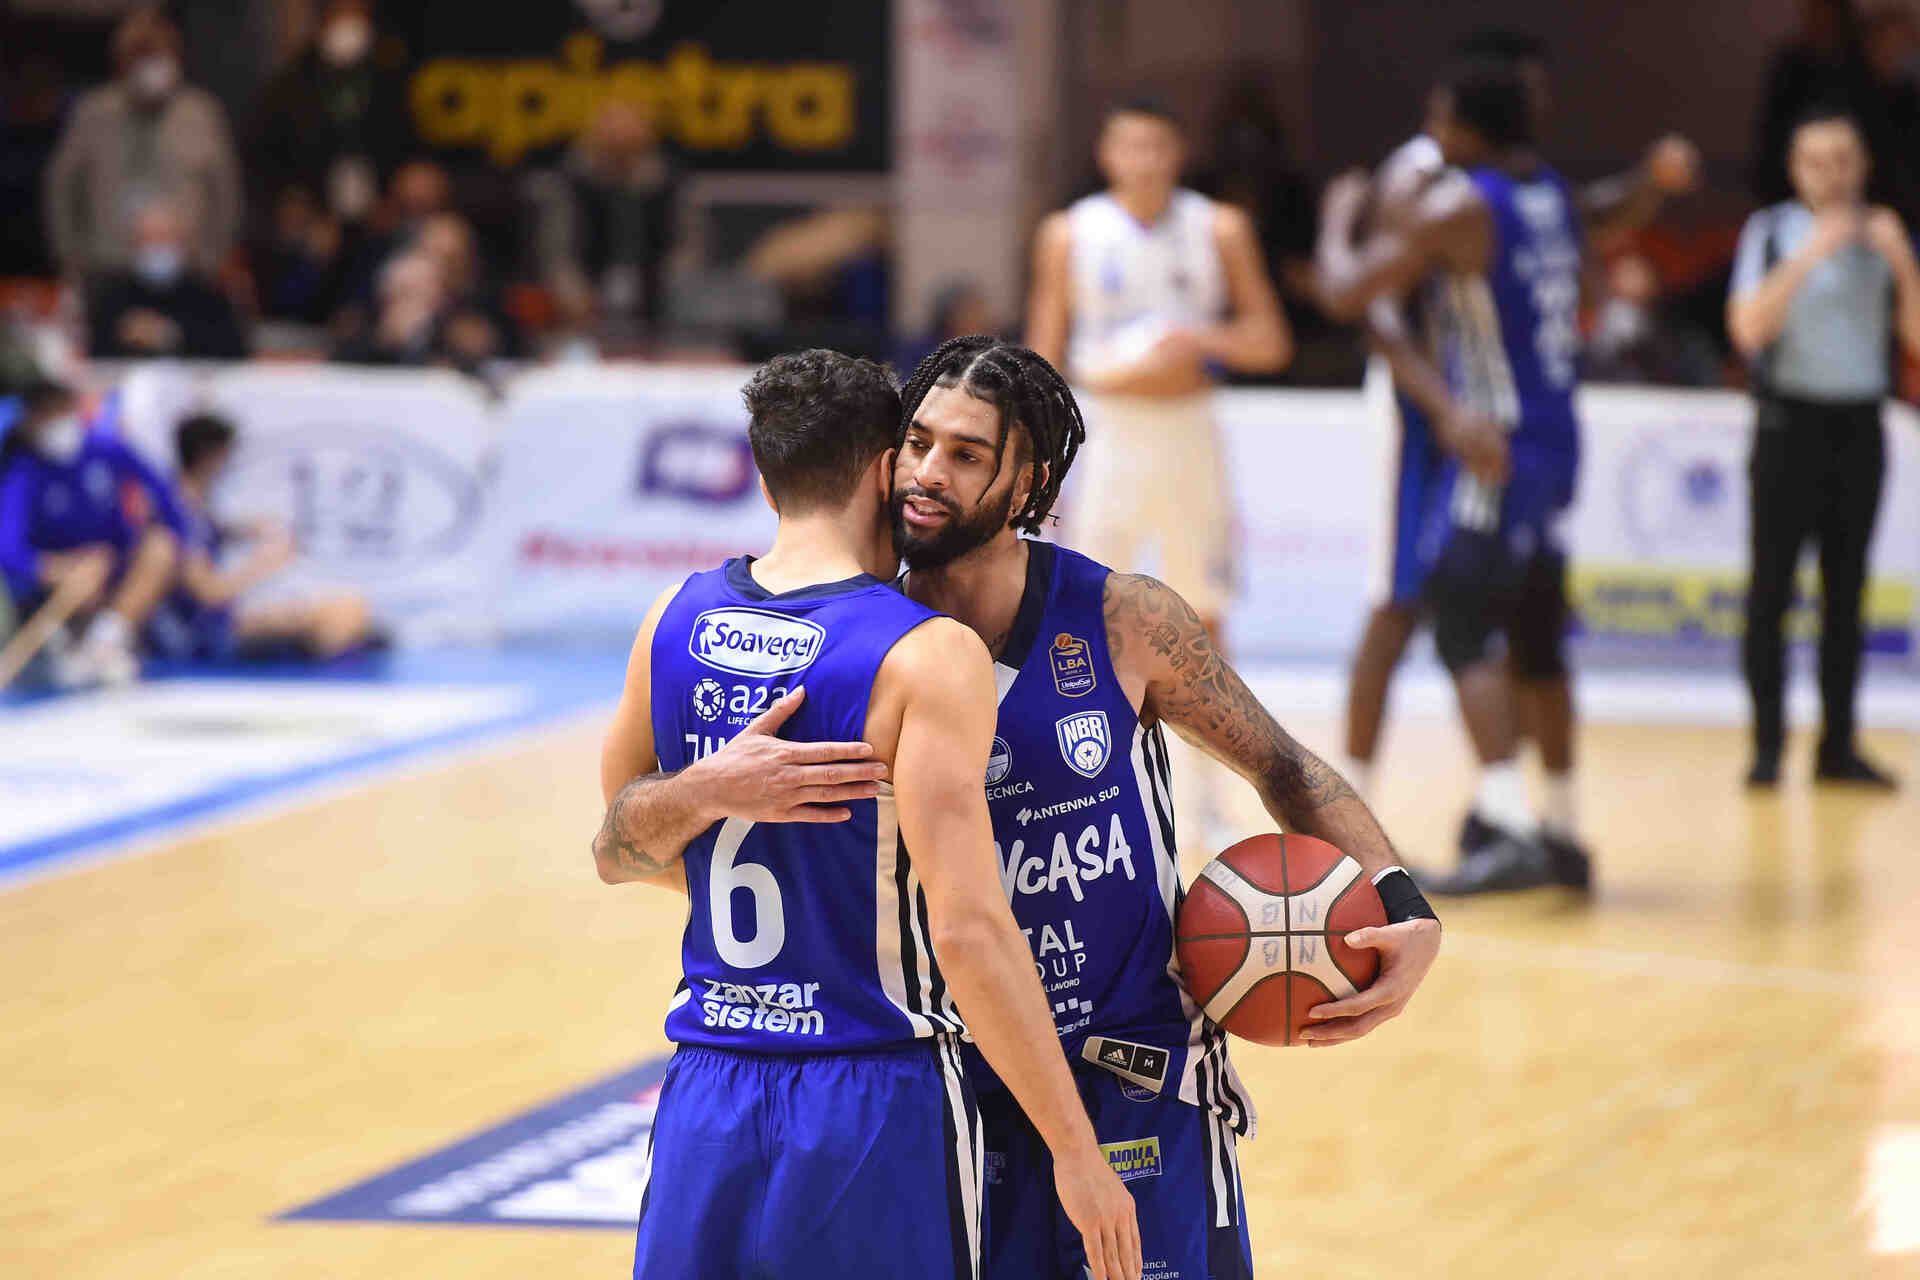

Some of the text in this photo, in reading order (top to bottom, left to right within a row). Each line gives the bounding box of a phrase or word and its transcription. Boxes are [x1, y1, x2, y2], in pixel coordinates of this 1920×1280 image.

[711, 622, 816, 661] Soavegel
[1057, 657, 1087, 671] LBA
[1062, 716, 1105, 755] NBB
[987, 781, 1034, 801] ECNICA
[1033, 785, 1121, 821] ANTENNA SUD
[709, 816, 785, 969] 6
[703, 978, 820, 1010] zanzar
[1050, 977, 1080, 992] LAVORO
[703, 1001, 824, 1036] sistem
[1108, 1145, 1156, 1171] NOVA
